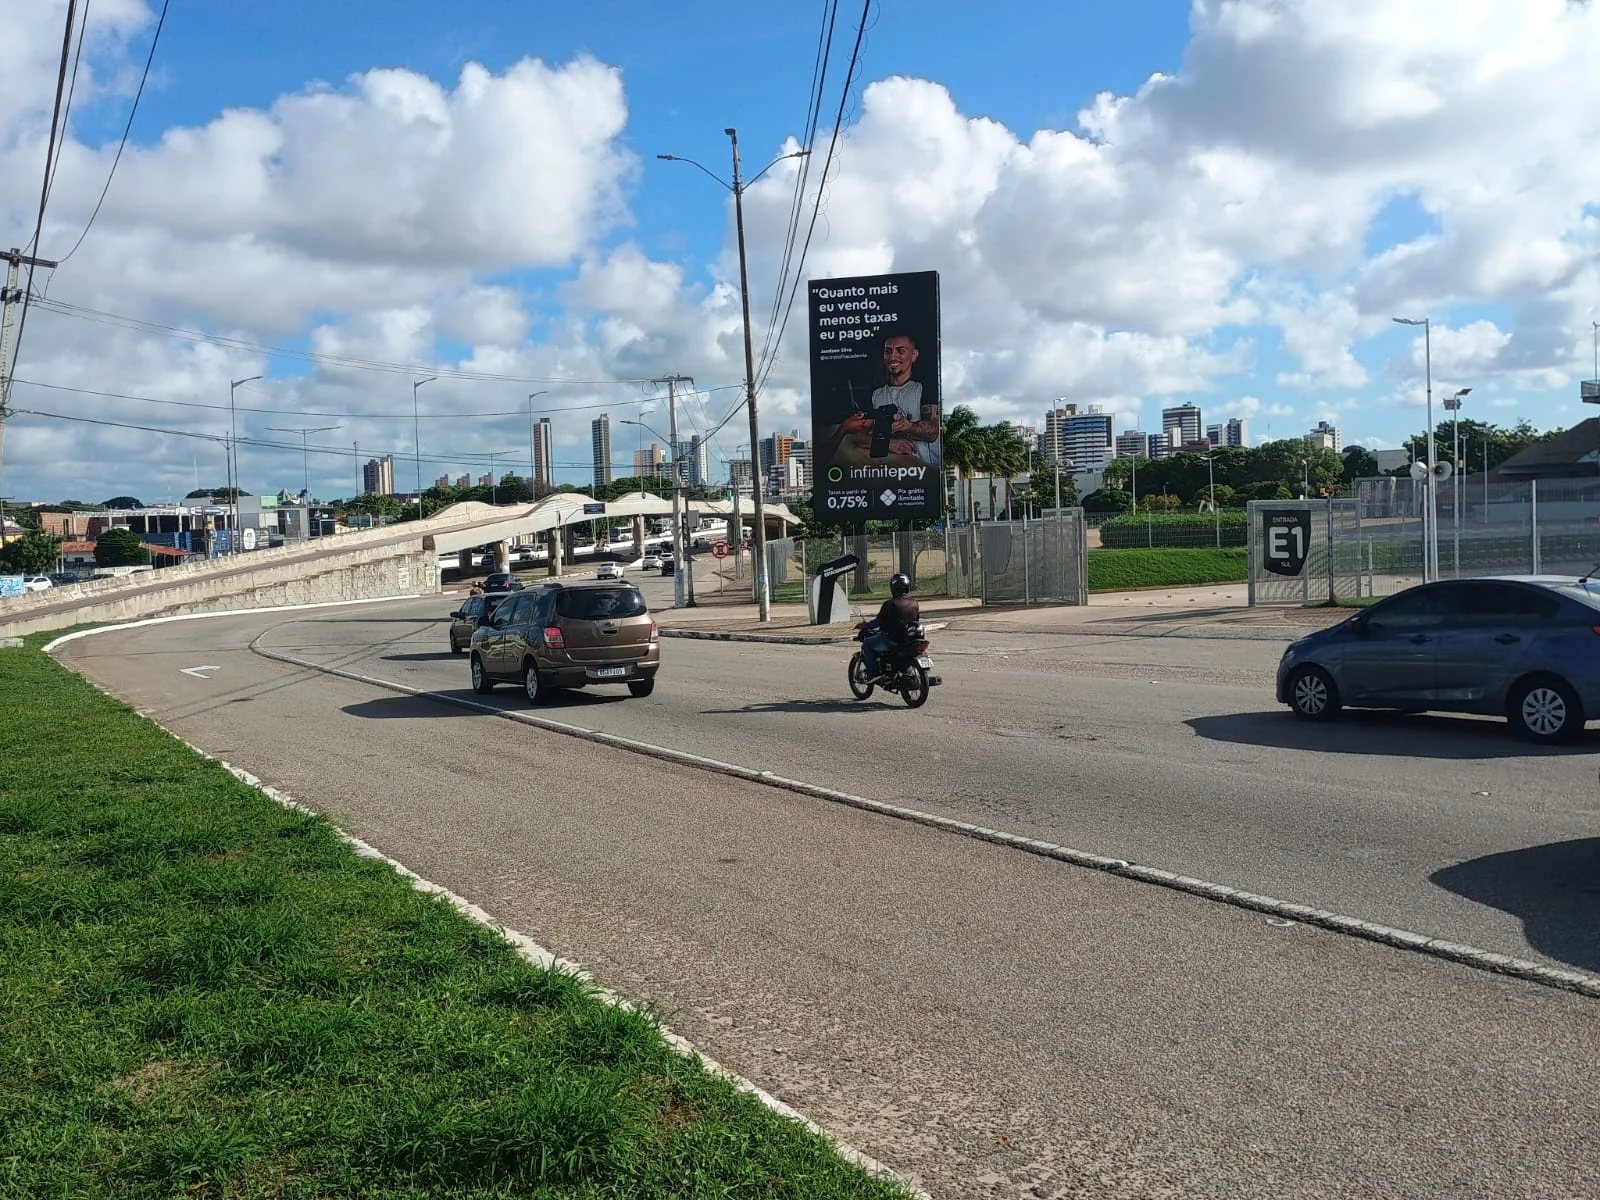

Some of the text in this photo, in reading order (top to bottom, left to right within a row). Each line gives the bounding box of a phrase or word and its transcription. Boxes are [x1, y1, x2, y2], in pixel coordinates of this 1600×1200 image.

[812, 282, 898, 299] "Quanto mais
[819, 298, 880, 312] eu vendo,
[820, 313, 898, 326] menos taxas
[820, 326, 880, 341] eu pago."
[850, 465, 926, 480] infinitepay
[827, 495, 868, 509] 0,75%
[1269, 526, 1304, 559] E1
